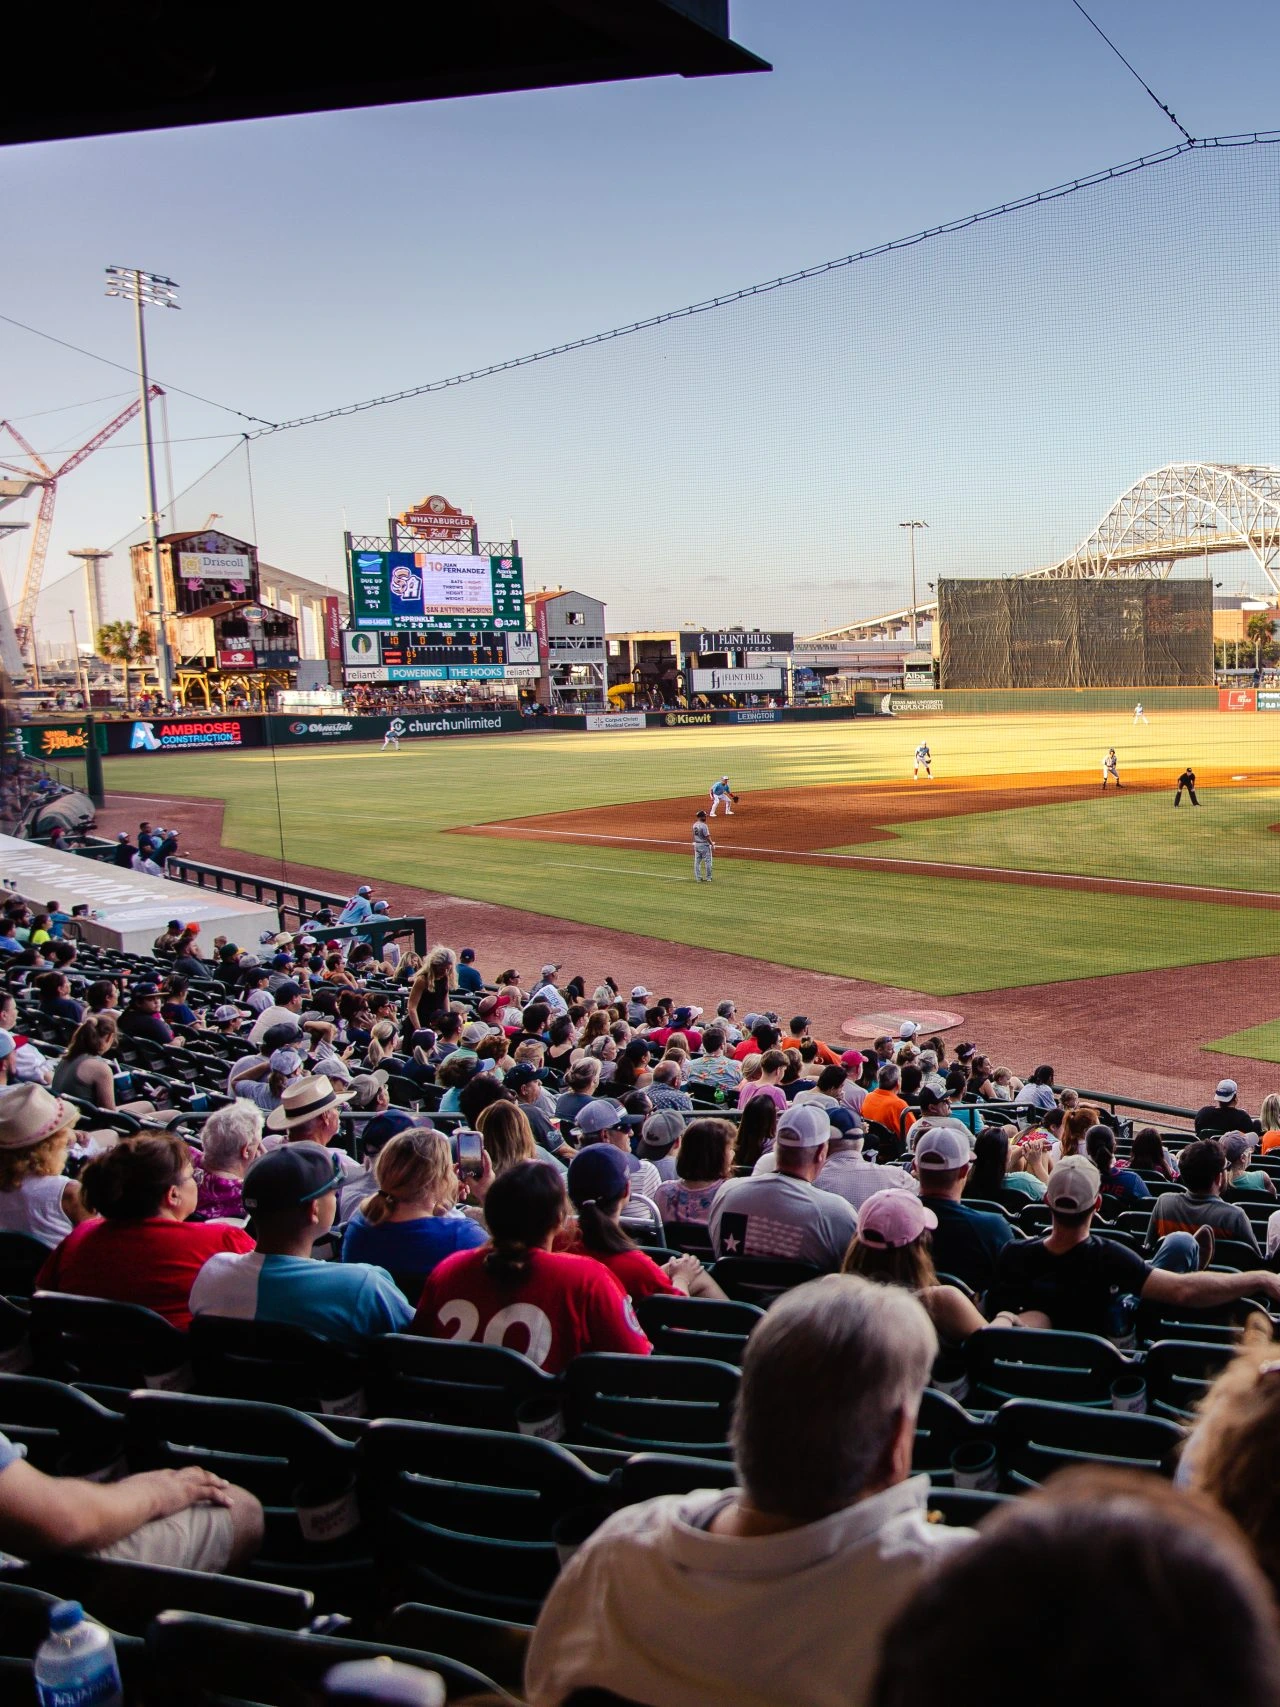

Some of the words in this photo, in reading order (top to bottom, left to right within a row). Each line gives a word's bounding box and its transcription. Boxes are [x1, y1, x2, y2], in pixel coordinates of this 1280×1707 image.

[409, 515, 470, 526] WHATABURGER
[429, 528, 449, 539] Field
[203, 557, 244, 567] Driscoll
[429, 561, 443, 572] 10
[514, 633, 532, 647] JM
[719, 634, 744, 645] FLINT
[746, 634, 772, 644] HILLS
[348, 669, 377, 680] reliant
[392, 669, 442, 678] POWERING
[451, 668, 468, 677] THE
[470, 667, 502, 676] HOOKS
[506, 668, 530, 676] reliant
[747, 673, 764, 681] HILLS
[677, 713, 712, 724] Kiewit
[737, 712, 775, 721] LEXINGTON
[160, 723, 231, 735] AMBROSE
[408, 717, 450, 732] church
[450, 716, 502, 731] unlimited
[162, 733, 233, 744] CONSTRUCTION
[36, 873, 169, 905] HOOKS
[437, 1299, 553, 1368] 20
